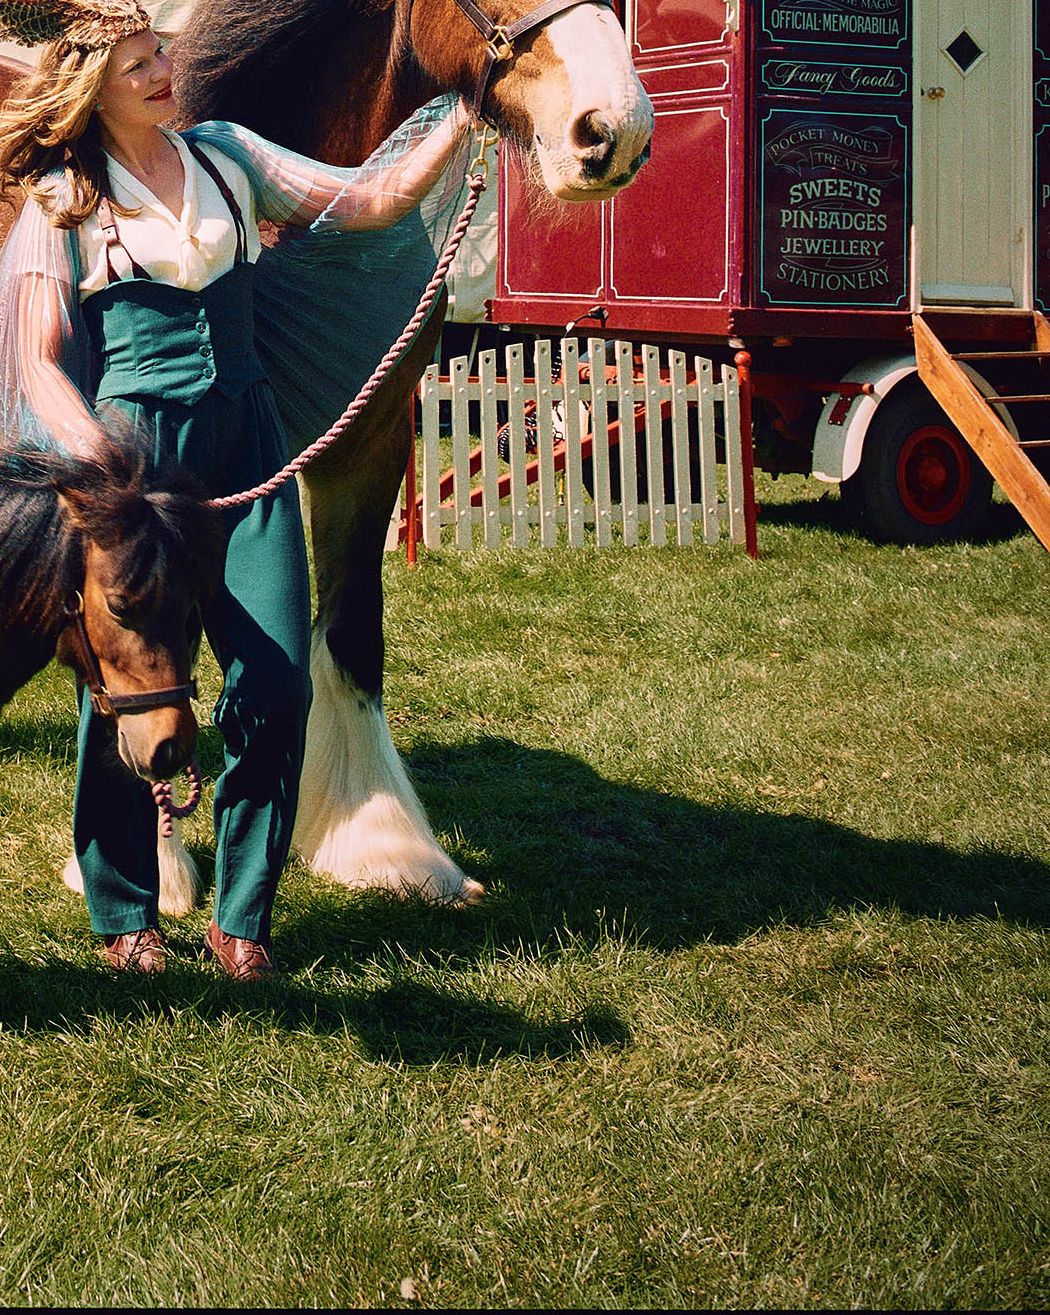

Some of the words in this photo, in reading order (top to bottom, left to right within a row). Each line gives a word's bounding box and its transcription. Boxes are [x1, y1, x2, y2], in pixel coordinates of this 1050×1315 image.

[770, 63, 838, 95] Fancy
[840, 67, 901, 91] Goods
[770, 129, 827, 156] POCKET
[832, 131, 881, 154] MONEY
[814, 152, 868, 174] TREATS
[790, 178, 882, 208] SWEETS
[780, 237, 885, 257] JEWELLERY
[776, 262, 890, 291] STATIONERY
